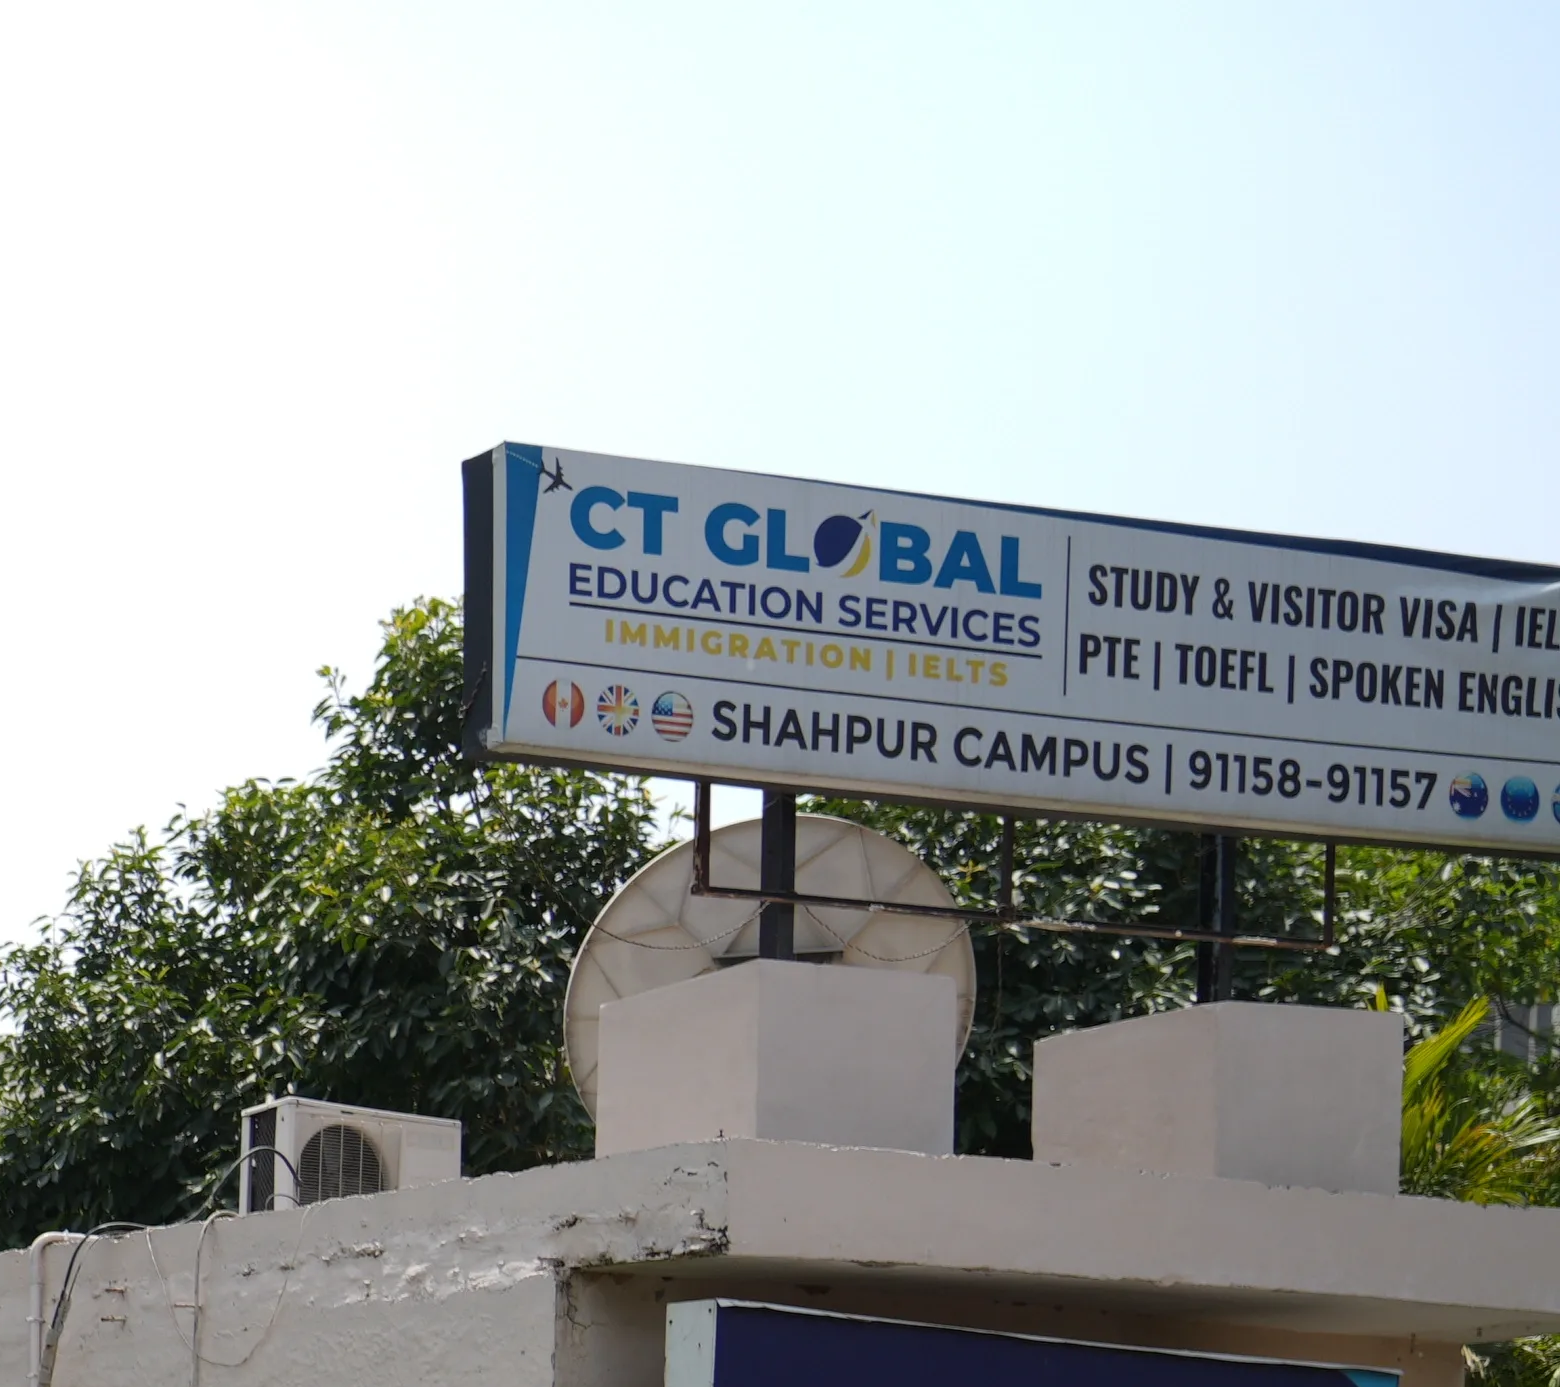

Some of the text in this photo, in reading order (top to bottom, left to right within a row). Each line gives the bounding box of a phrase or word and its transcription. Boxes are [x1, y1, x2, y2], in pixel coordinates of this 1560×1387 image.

[570, 485, 1042, 599] CT GLOBAL
[569, 563, 1041, 648] EDUCATION SERVICES
[1088, 564, 1200, 616] STUDY
[1212, 578, 1234, 620] &
[1248, 581, 1386, 635] VISITOR
[1400, 596, 1479, 643] VISA
[605, 618, 1009, 687] IMMIGRATION IELTS
[1078, 633, 1560, 720] PTE TOEFL SPOKEN ENGLI
[711, 700, 1437, 810] SHAHPUR CAMPUS 91158-91157
